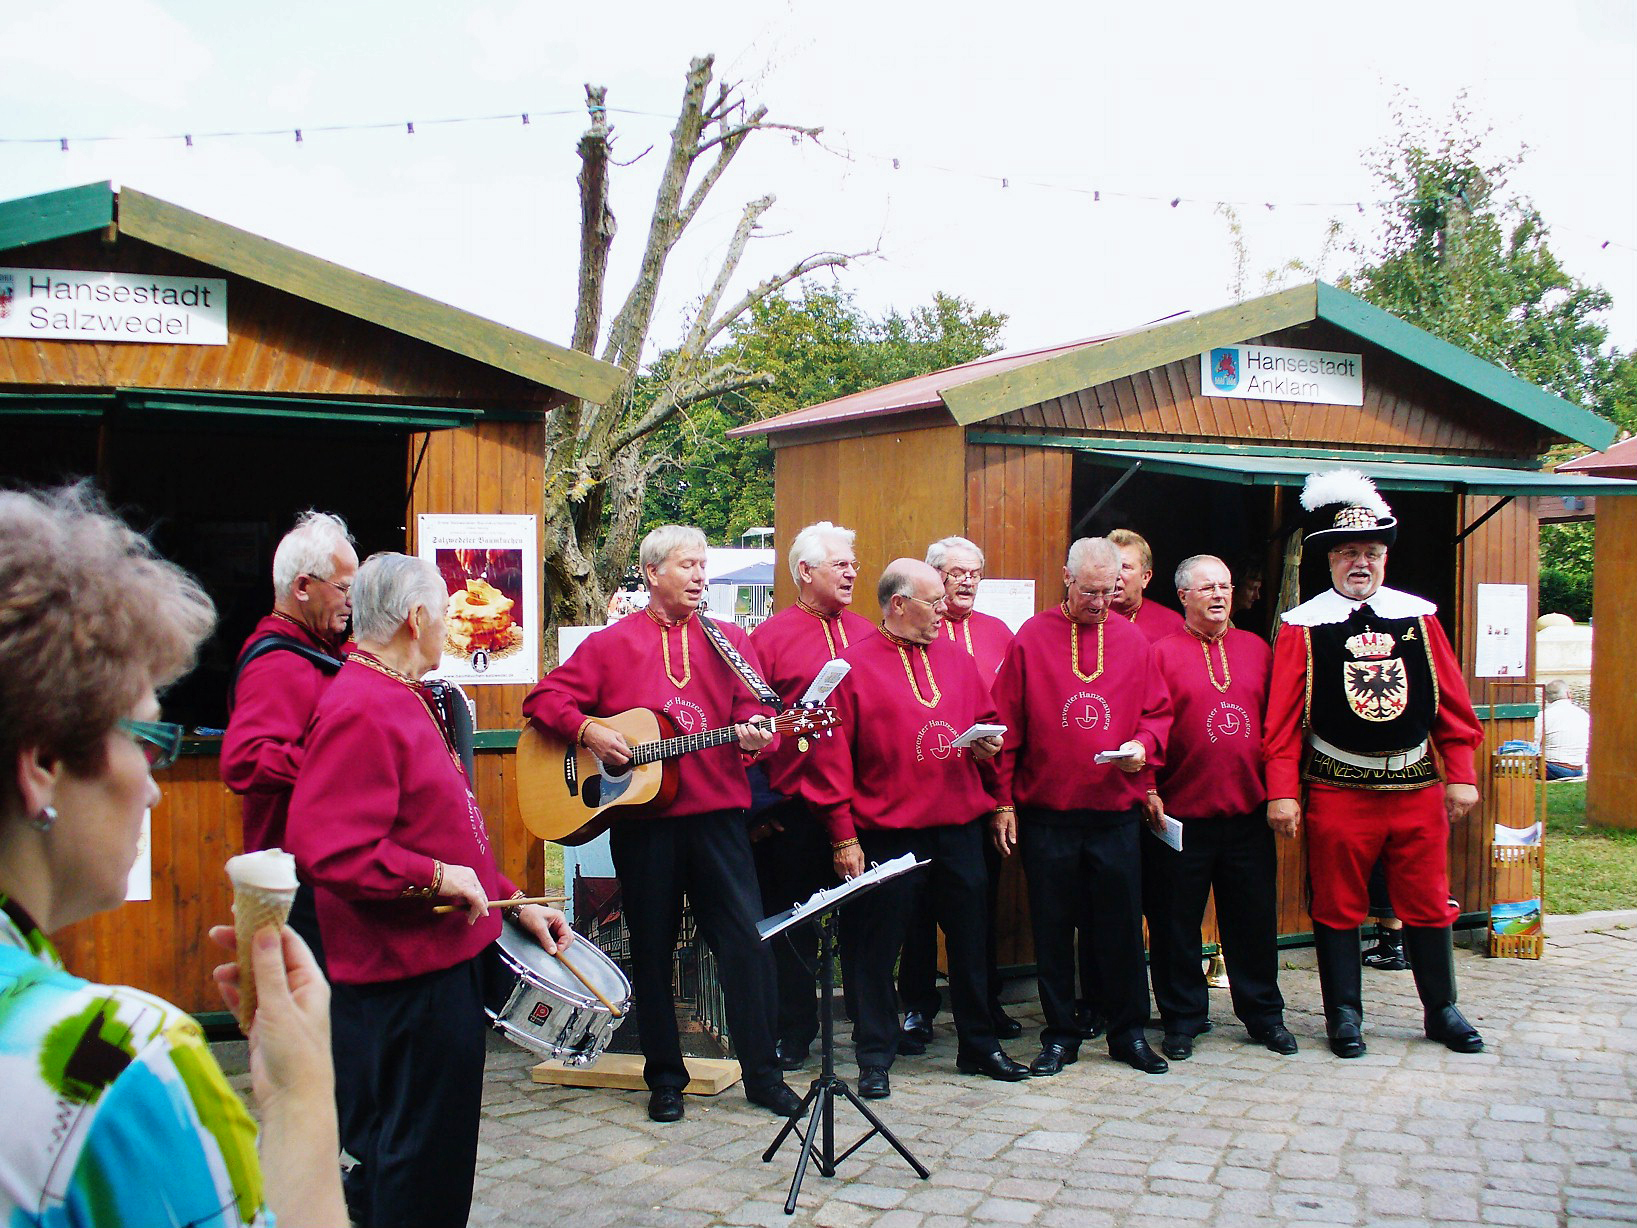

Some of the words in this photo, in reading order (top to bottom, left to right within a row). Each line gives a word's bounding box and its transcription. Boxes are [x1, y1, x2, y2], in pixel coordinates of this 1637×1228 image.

[30, 276, 211, 307] Hansestadt
[30, 306, 190, 335] Salzwedel
[1247, 351, 1355, 377] Hansestadt
[1247, 375, 1319, 397] Anklam
[663, 699, 674, 713] nter
[675, 697, 707, 731] Hanzezange
